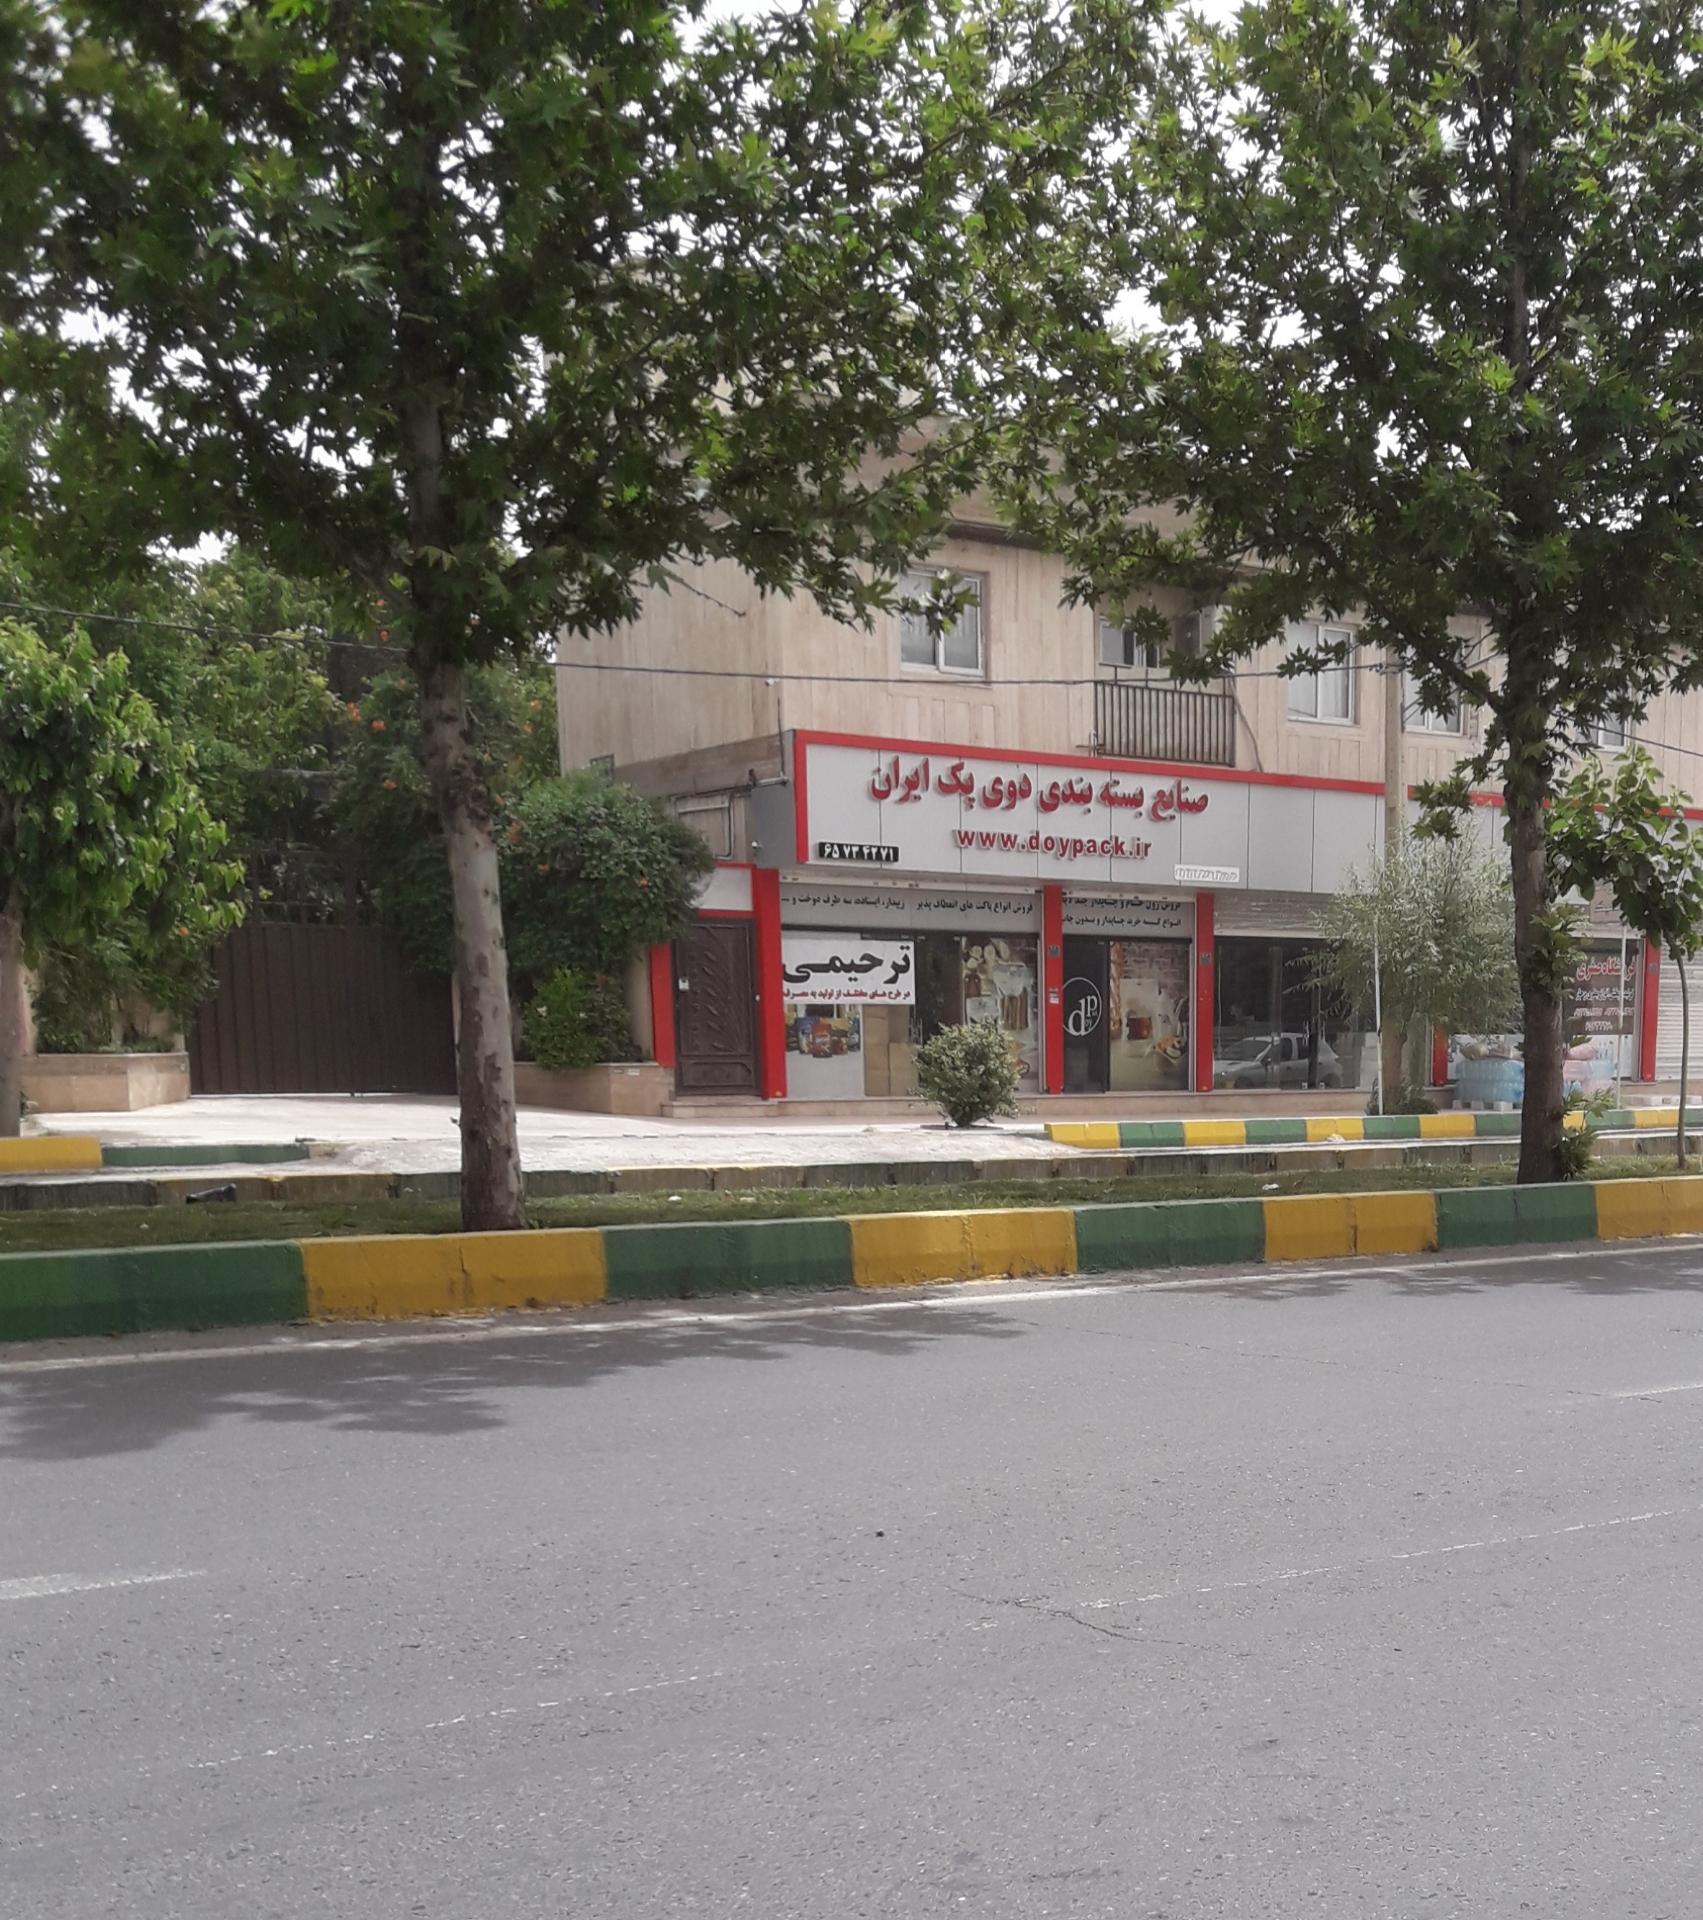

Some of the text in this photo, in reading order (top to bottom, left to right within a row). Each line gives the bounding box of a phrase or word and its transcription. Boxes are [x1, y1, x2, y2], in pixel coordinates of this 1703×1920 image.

[870, 754, 1209, 822] صنایع بسته بندی دوی پک ایران
[956, 828, 1153, 859] www.doypack.ir
[782, 944, 911, 985] ترحیمی
